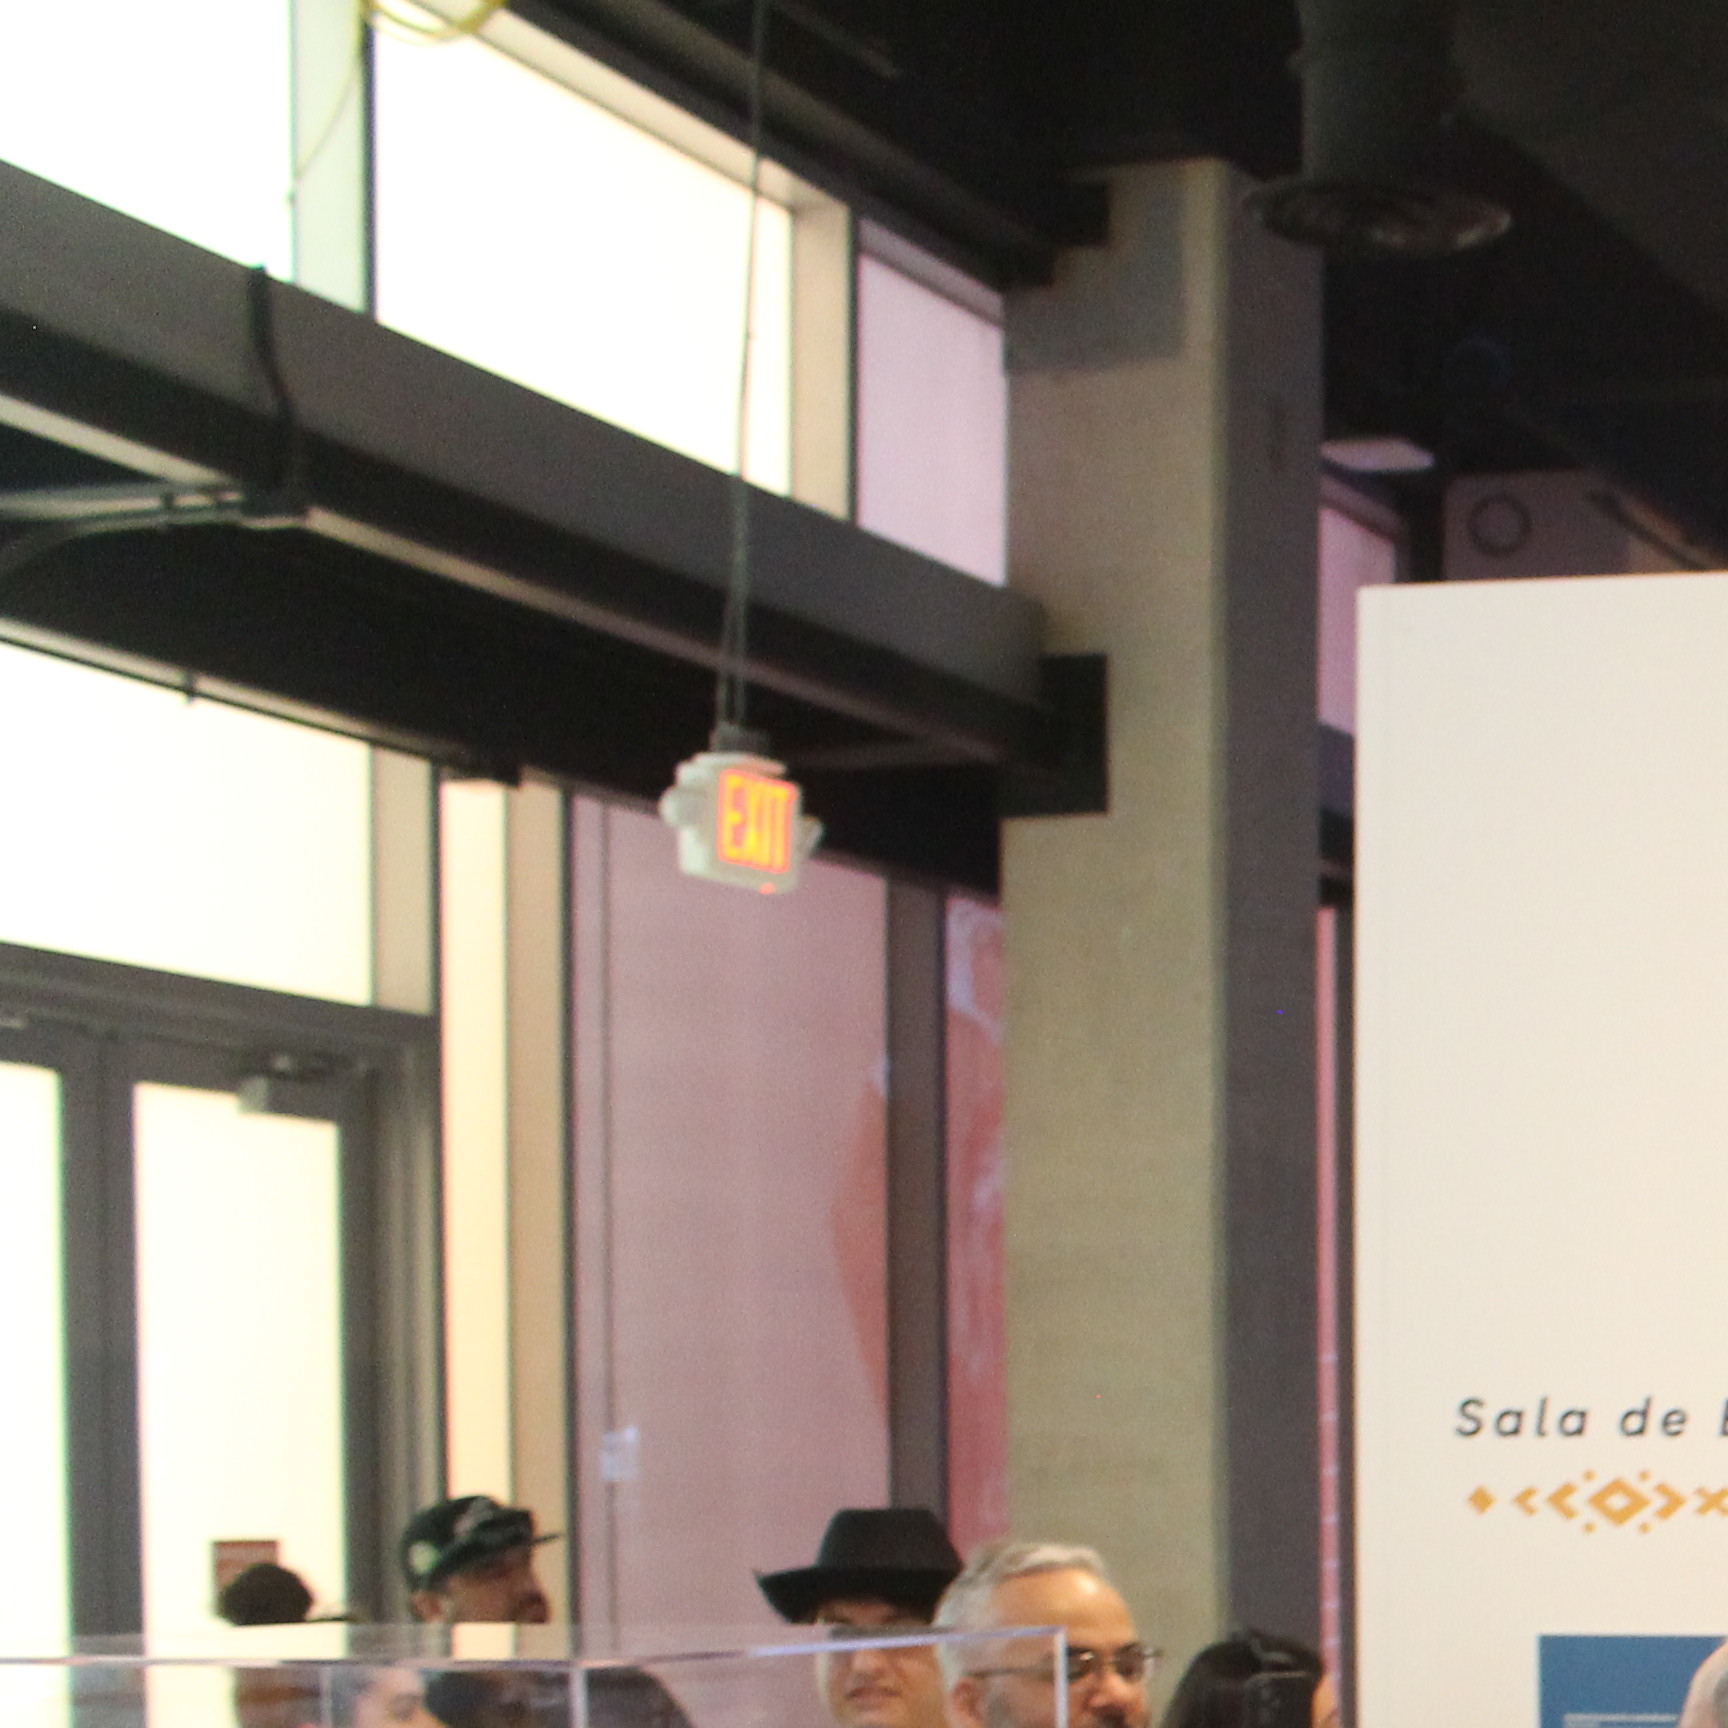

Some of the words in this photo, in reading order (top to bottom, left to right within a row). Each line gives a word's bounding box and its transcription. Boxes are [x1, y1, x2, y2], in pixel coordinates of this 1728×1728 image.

[722, 772, 790, 868] EXIT
[1455, 1396, 1588, 1438] Sala
[1619, 1396, 1689, 1438] de
